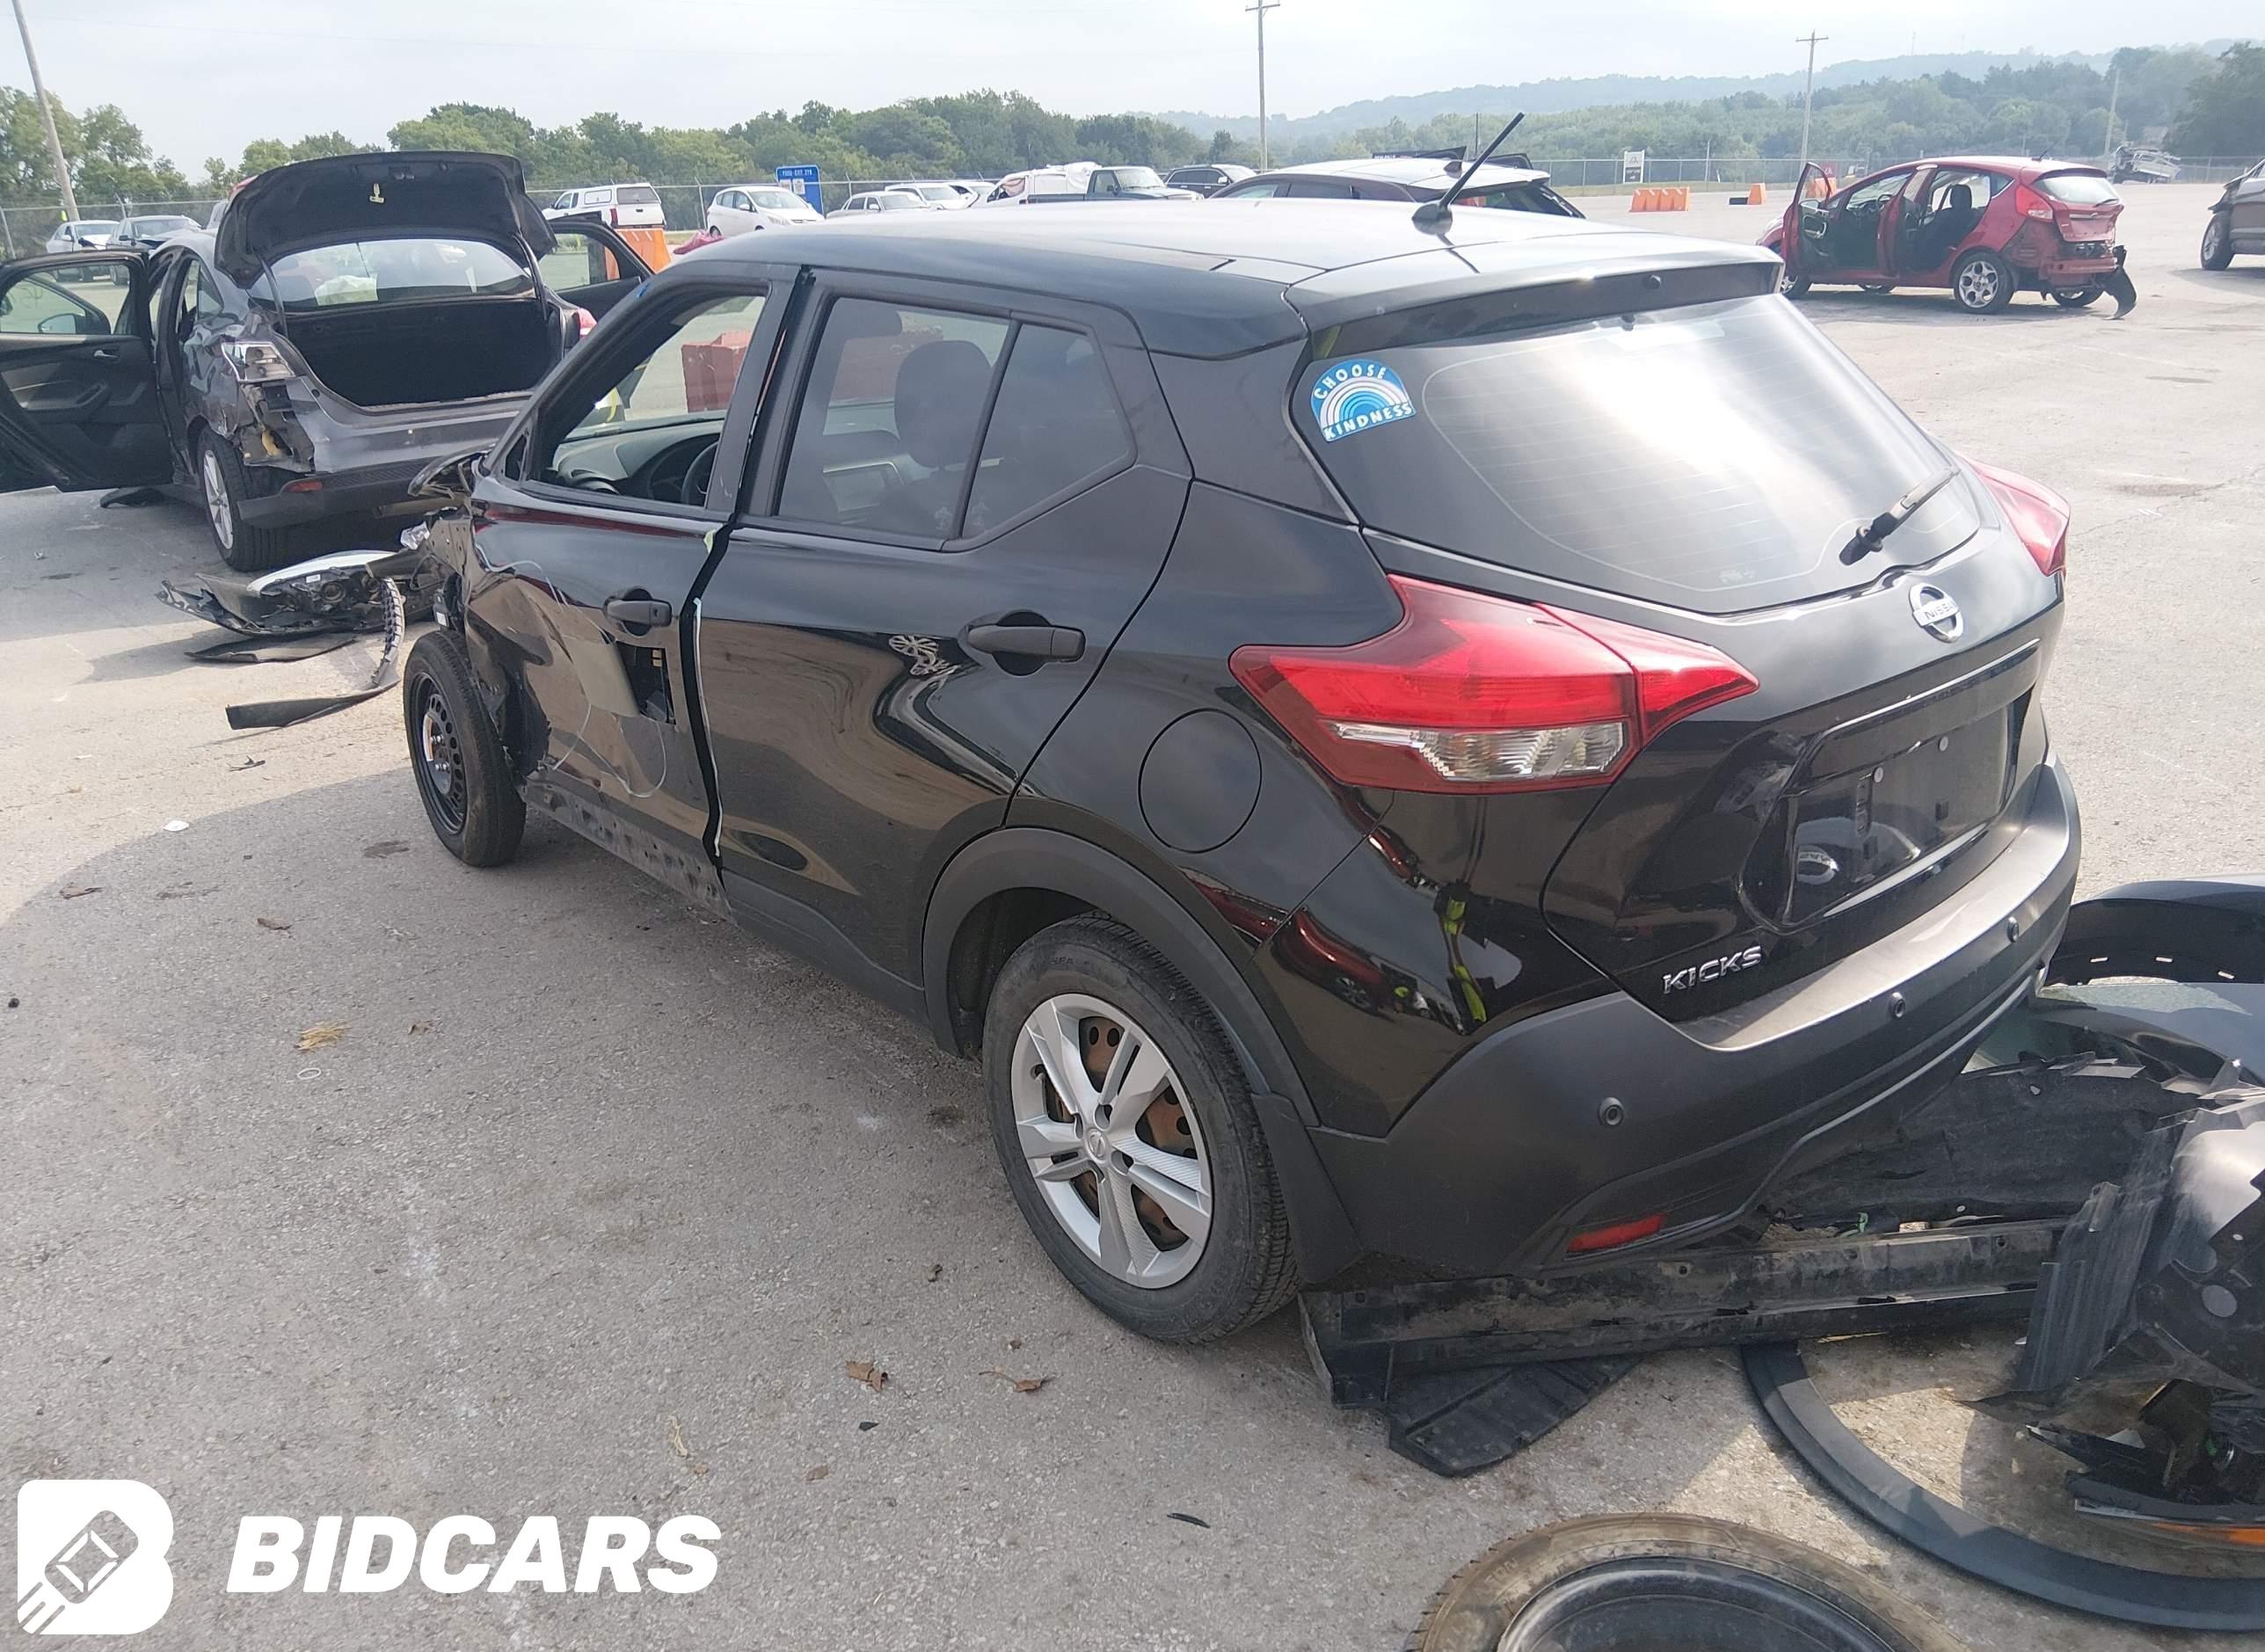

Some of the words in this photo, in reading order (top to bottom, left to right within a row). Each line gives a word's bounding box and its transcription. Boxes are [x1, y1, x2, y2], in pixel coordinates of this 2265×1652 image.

[1314, 364, 1387, 399] CHOOSE
[1323, 404, 1412, 440] KINDNESS
[1663, 945, 1761, 994] KICKS
